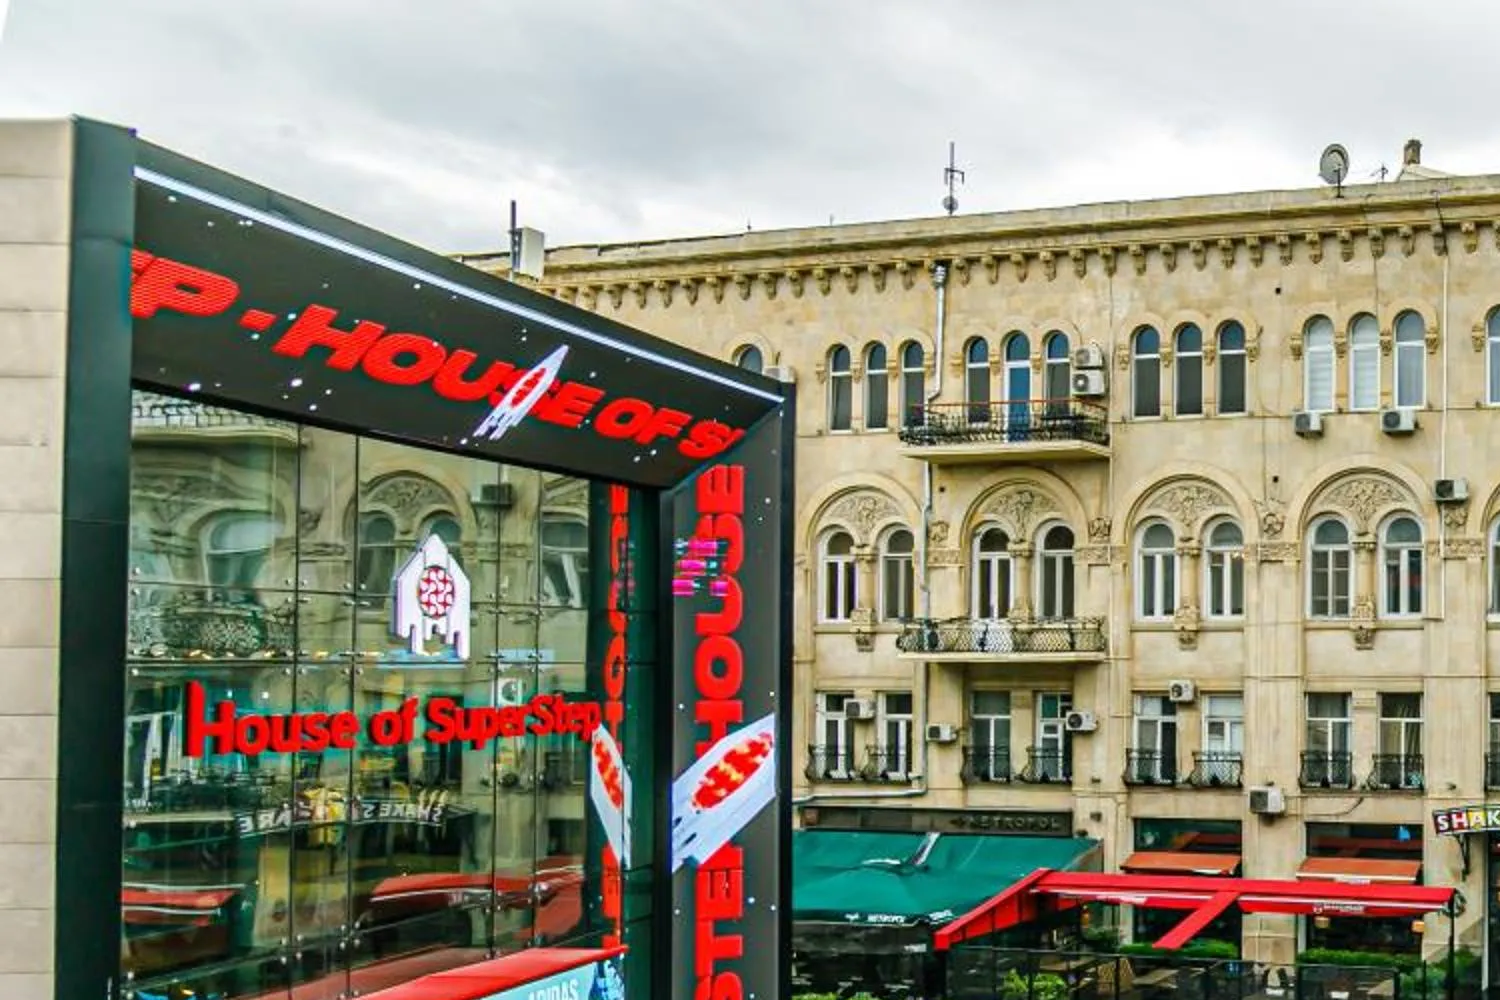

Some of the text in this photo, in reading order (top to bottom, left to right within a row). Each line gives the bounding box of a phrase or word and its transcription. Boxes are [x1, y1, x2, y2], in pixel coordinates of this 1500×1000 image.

[130, 246, 240, 319] P
[594, 396, 693, 445] OF
[183, 681, 601, 757] House of SuperStep
